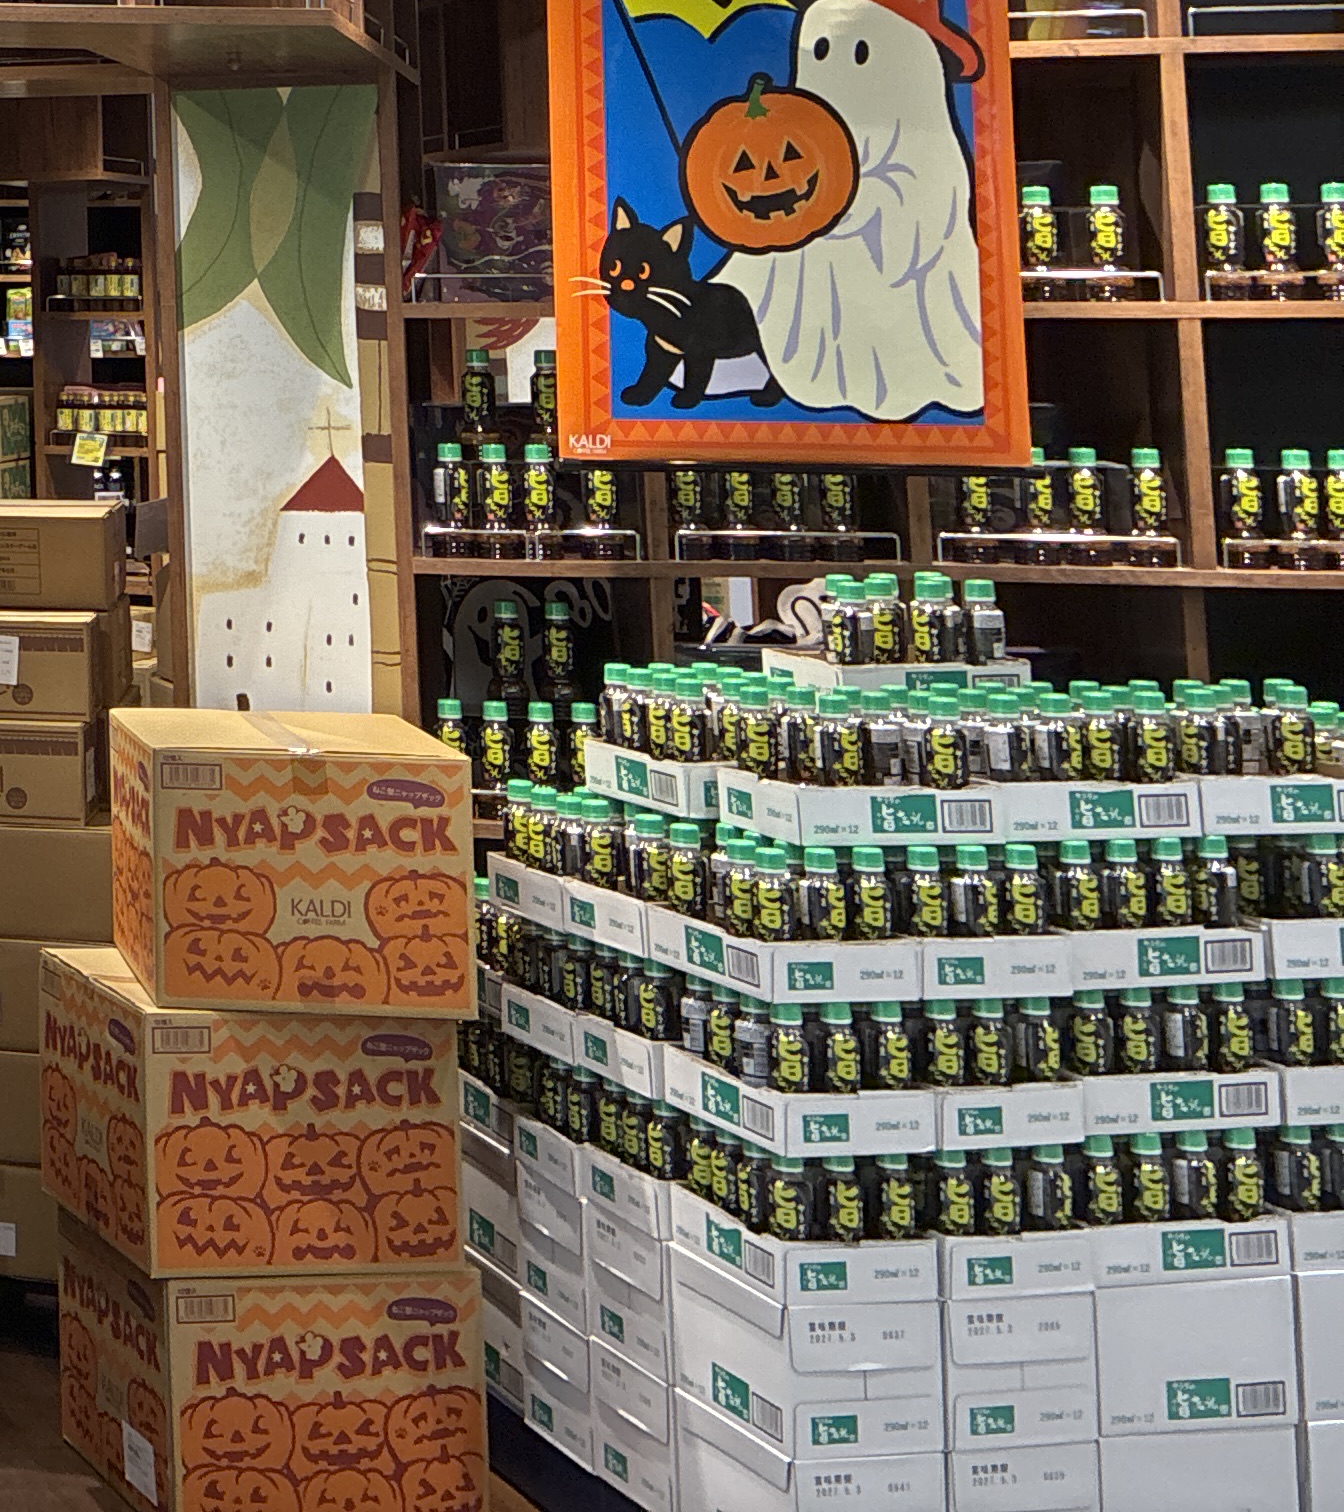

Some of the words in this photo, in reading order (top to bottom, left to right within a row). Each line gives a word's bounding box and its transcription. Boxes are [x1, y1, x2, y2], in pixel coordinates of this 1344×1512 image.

[569, 434, 611, 448] KALDI
[174, 806, 458, 856] NYAPSACK
[291, 899, 351, 918] KALDI
[44, 1009, 140, 1102] NYAPSACK
[170, 1066, 441, 1115] NYAPSACK
[64, 1258, 161, 1373] NYAPSACK
[196, 1330, 466, 1386] NYAPSACK
